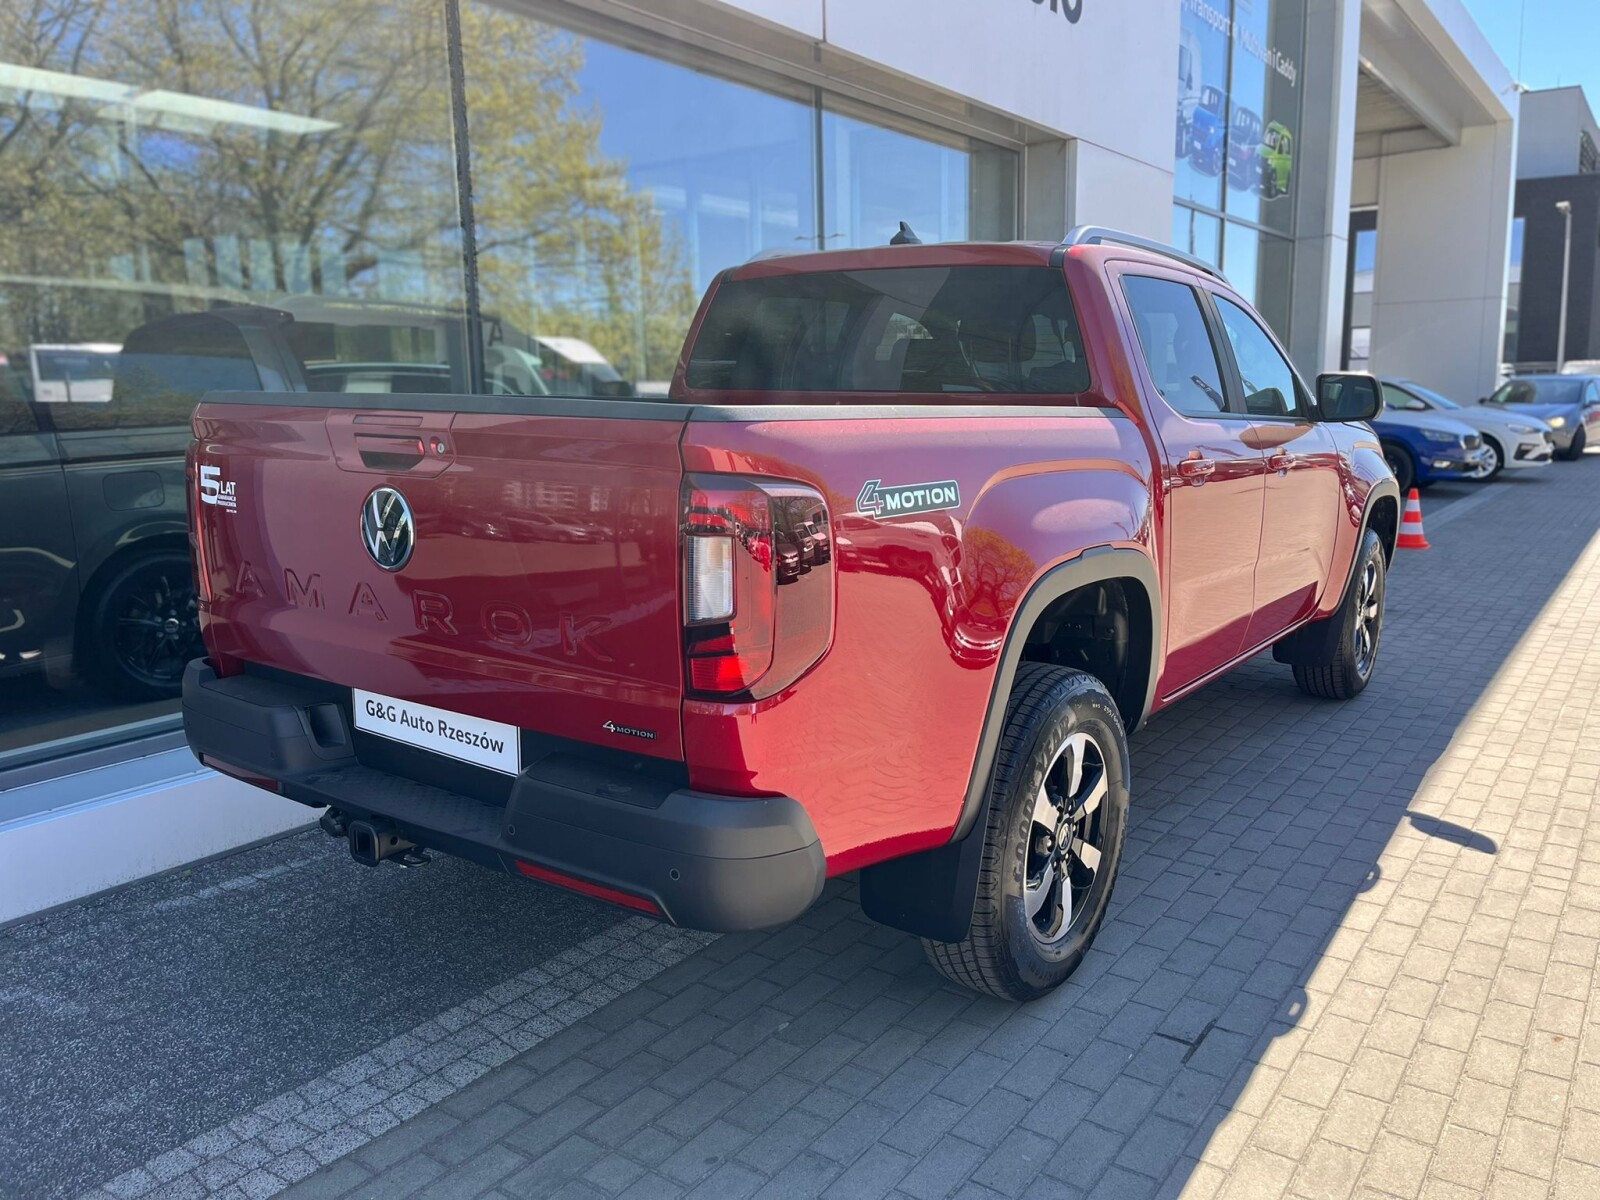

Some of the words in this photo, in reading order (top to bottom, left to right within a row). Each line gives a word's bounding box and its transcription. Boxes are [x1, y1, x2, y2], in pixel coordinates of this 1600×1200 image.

[1276, 51, 1297, 88] Caddy
[200, 465, 221, 505] 5
[220, 480, 236, 496] LAT
[858, 484, 957, 515] 4MOTION
[235, 559, 615, 664] AMAROK
[365, 699, 396, 723] G&G
[400, 709, 434, 734] Auto
[438, 719, 504, 754] Rzeszów
[603, 720, 654, 739] 4MOTION
